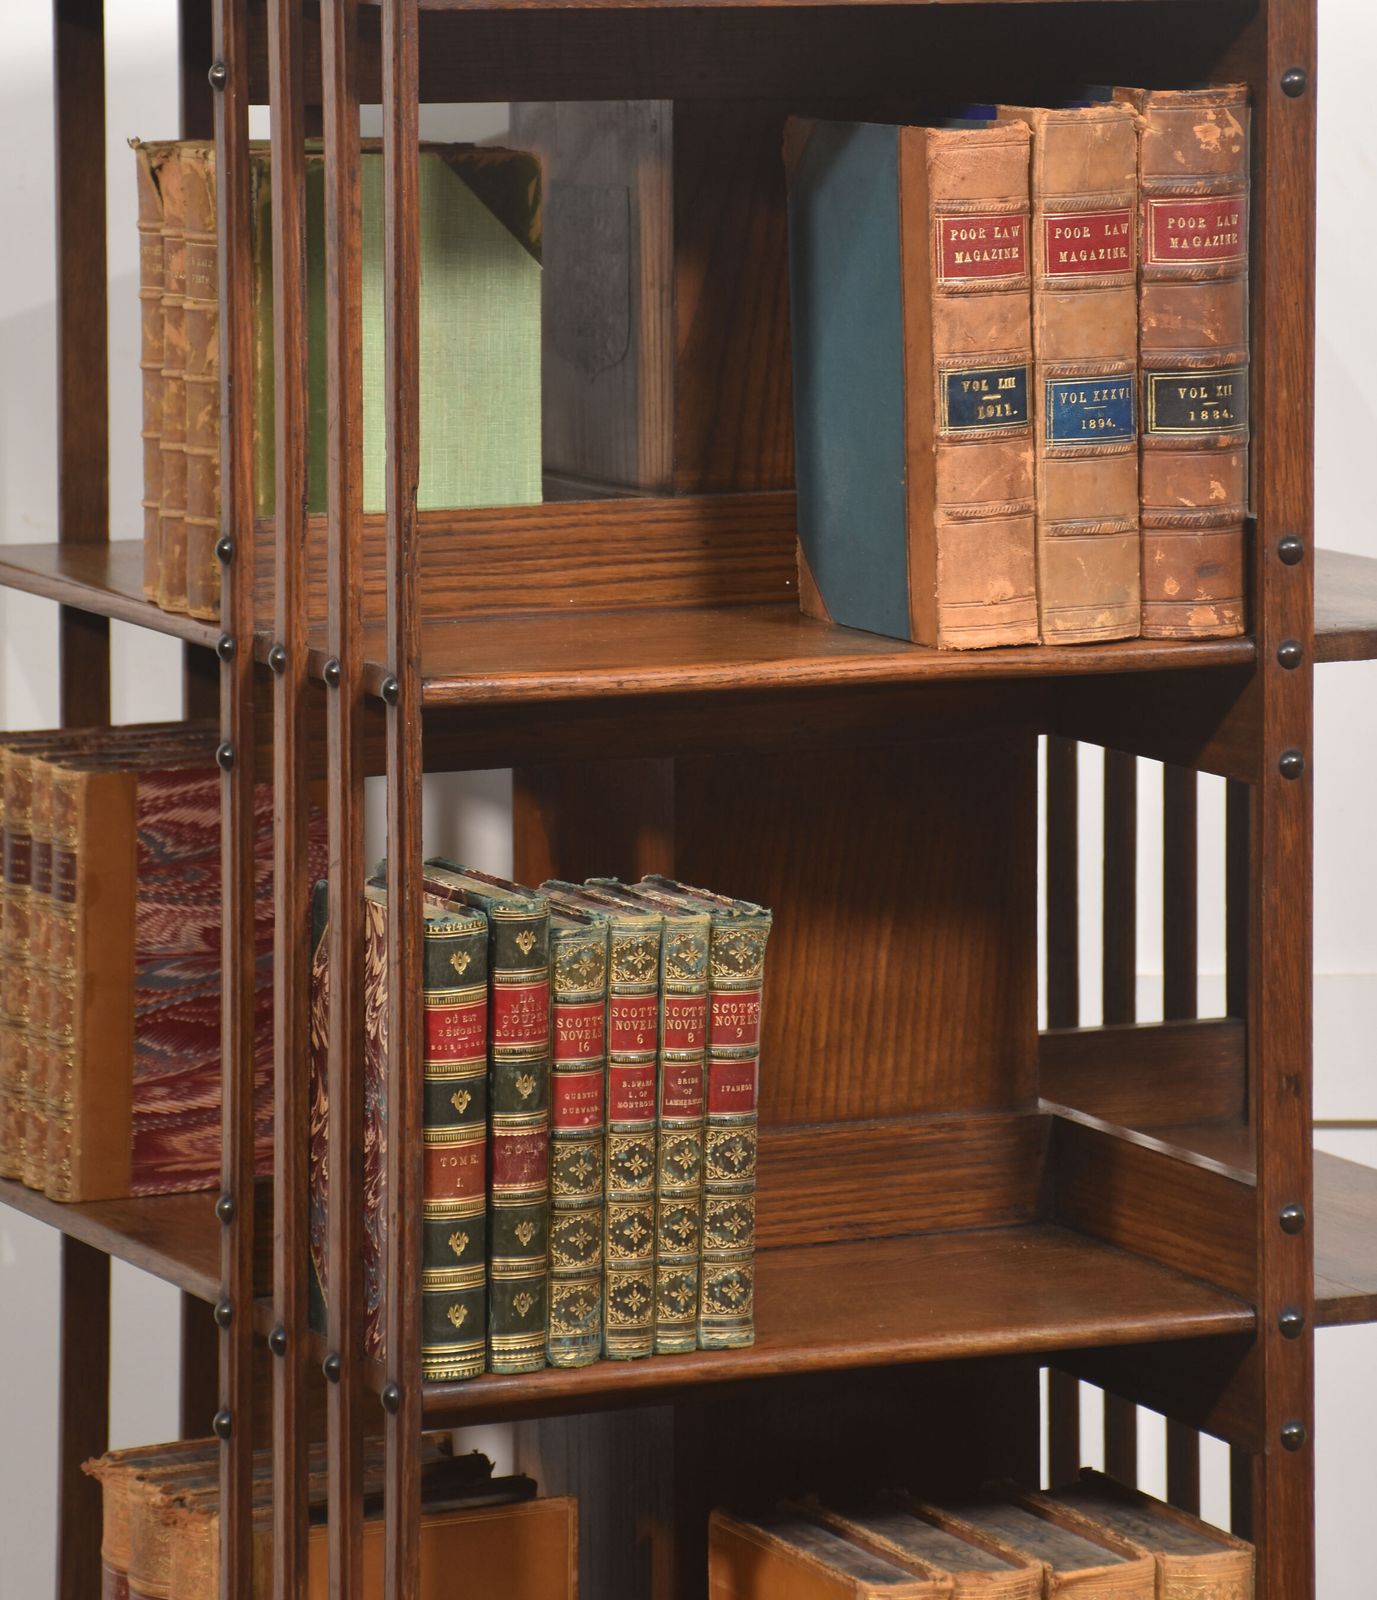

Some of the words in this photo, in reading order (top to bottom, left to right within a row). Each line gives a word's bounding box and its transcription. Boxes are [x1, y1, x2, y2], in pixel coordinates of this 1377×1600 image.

[1167, 217, 1206, 229] POOR
[1216, 214, 1239, 227] LAW
[950, 228, 986, 241] POOR
[993, 224, 1020, 238] LAW
[1054, 226, 1091, 239] POOR
[1104, 223, 1129, 236] LAW
[1169, 233, 1238, 249] MAGAZINE
[954, 247, 1019, 263] MAGAZINE
[961, 379, 989, 392] VOL
[1178, 387, 1208, 399] VOL
[1216, 384, 1233, 397] XII
[1060, 392, 1087, 404] VOL
[1092, 387, 1130, 402] XXXVI
[977, 403, 1018, 420] 1911.
[1189, 409, 1234, 421] 1884.
[1081, 418, 1116, 430] 1894.
[712, 1002, 760, 1014] SCOTT'S
[556, 1015, 604, 1029] SCOTT'S
[714, 1014, 758, 1026] NOVELS
[560, 1028, 602, 1041] NOVELS
[636, 1033, 644, 1044] 6
[687, 1032, 694, 1043] 8
[735, 1027, 743, 1038] 9
[578, 1041, 590, 1052] 16
